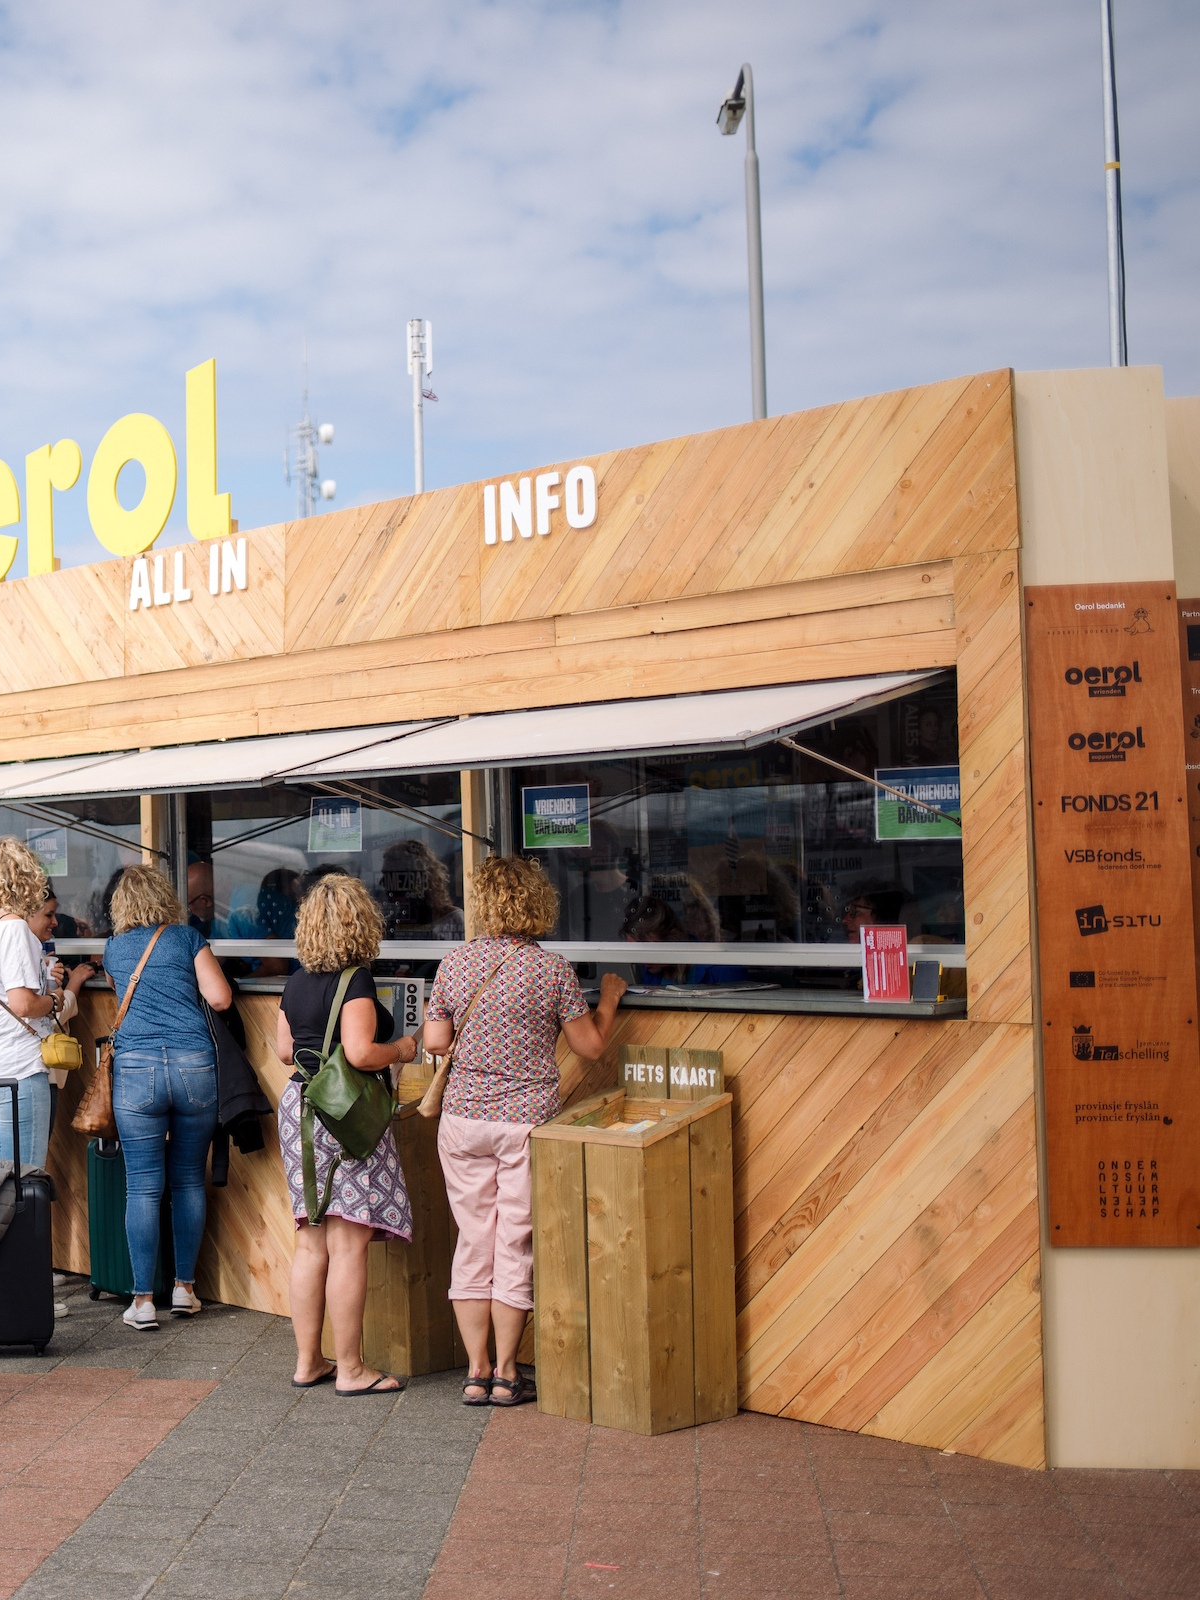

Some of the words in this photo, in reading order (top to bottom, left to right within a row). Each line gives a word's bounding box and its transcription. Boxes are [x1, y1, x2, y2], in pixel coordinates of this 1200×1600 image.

[483, 465, 597, 545] INFO
[129, 550, 192, 610] ALL
[209, 538, 247, 595] IN
[1096, 602, 1126, 610] bedankt
[1064, 661, 1143, 686] oerol
[1068, 726, 1146, 750] oerol
[1091, 753, 1124, 761] supporters
[401, 781, 428, 797] Tech
[885, 785, 906, 802] INFO
[912, 783, 959, 801] VRIENDEN
[535, 797, 576, 815] VRIENDEN
[1061, 794, 1131, 813] FONDS
[1135, 790, 1159, 811] 21
[406, 983, 418, 1028] oerol
[1099, 1047, 1170, 1062] Terschelling
[624, 1063, 664, 1083] FIETS
[670, 1066, 716, 1087] KAART
[1075, 1101, 1122, 1113] provinsje
[1124, 1100, 1160, 1112] fryslân
[1075, 1113, 1123, 1124] provincie
[1126, 1112, 1160, 1124] fryslân
[1098, 1160, 1157, 1170] ONDER
[1100, 1208, 1159, 1218] SCHAP
